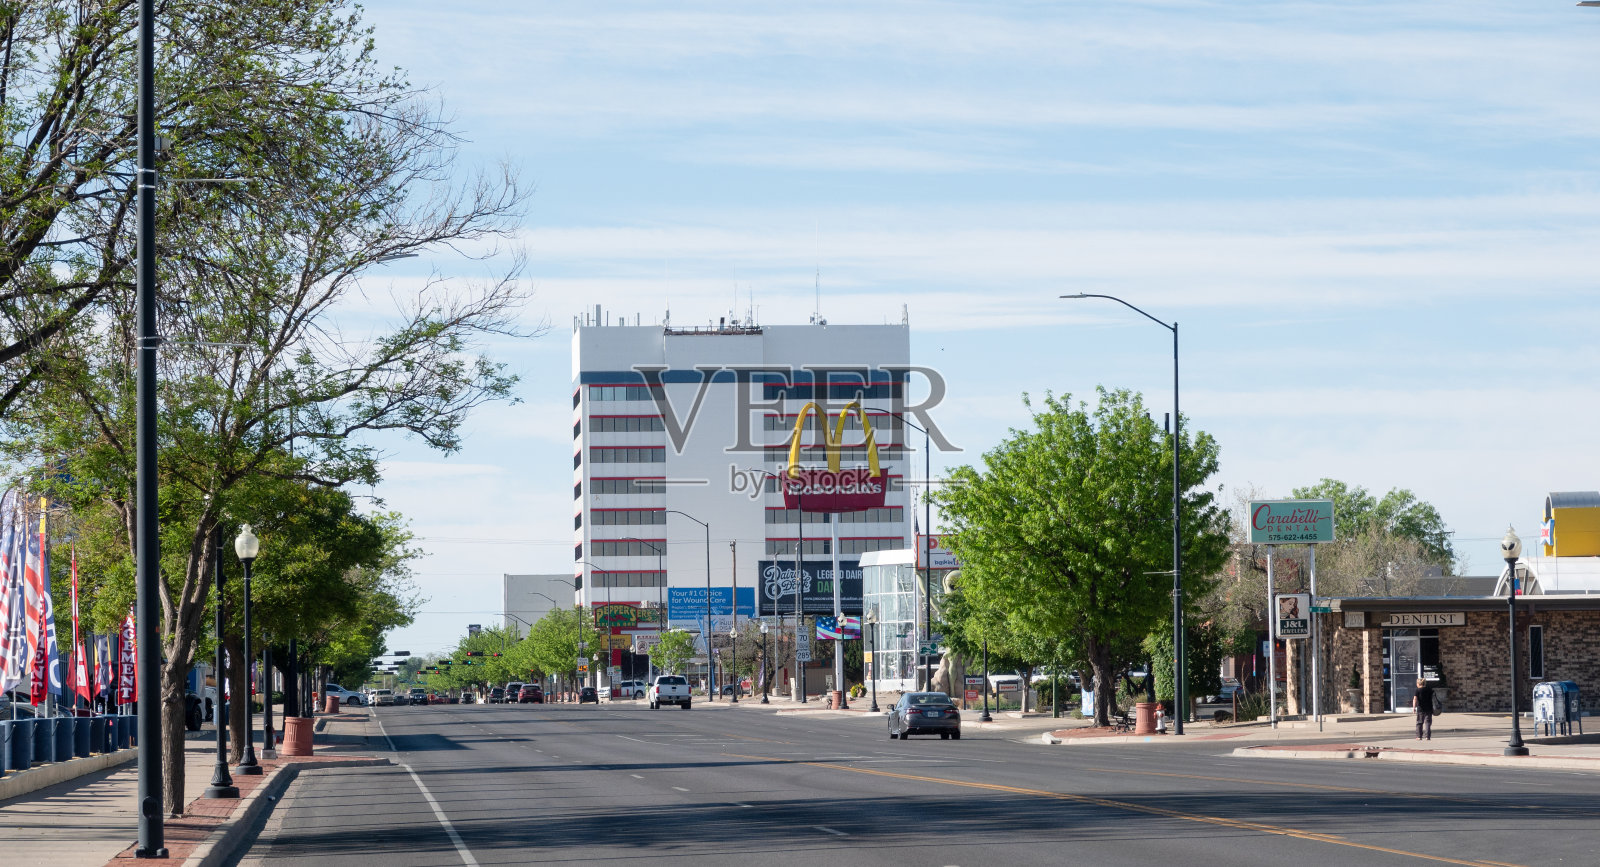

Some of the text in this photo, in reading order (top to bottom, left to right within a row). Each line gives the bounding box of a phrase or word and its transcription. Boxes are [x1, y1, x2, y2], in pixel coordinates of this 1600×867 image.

[1252, 504, 1330, 530] Carabelli
[1268, 533, 1318, 541] 575-622-4455
[816, 569, 864, 580] LEGED DAIR
[596, 605, 637, 622] PEPPERS
[1390, 613, 1457, 625] DENTIST
[1283, 620, 1304, 629] J&L
[799, 634, 808, 642] 70
[797, 652, 810, 660] 285
